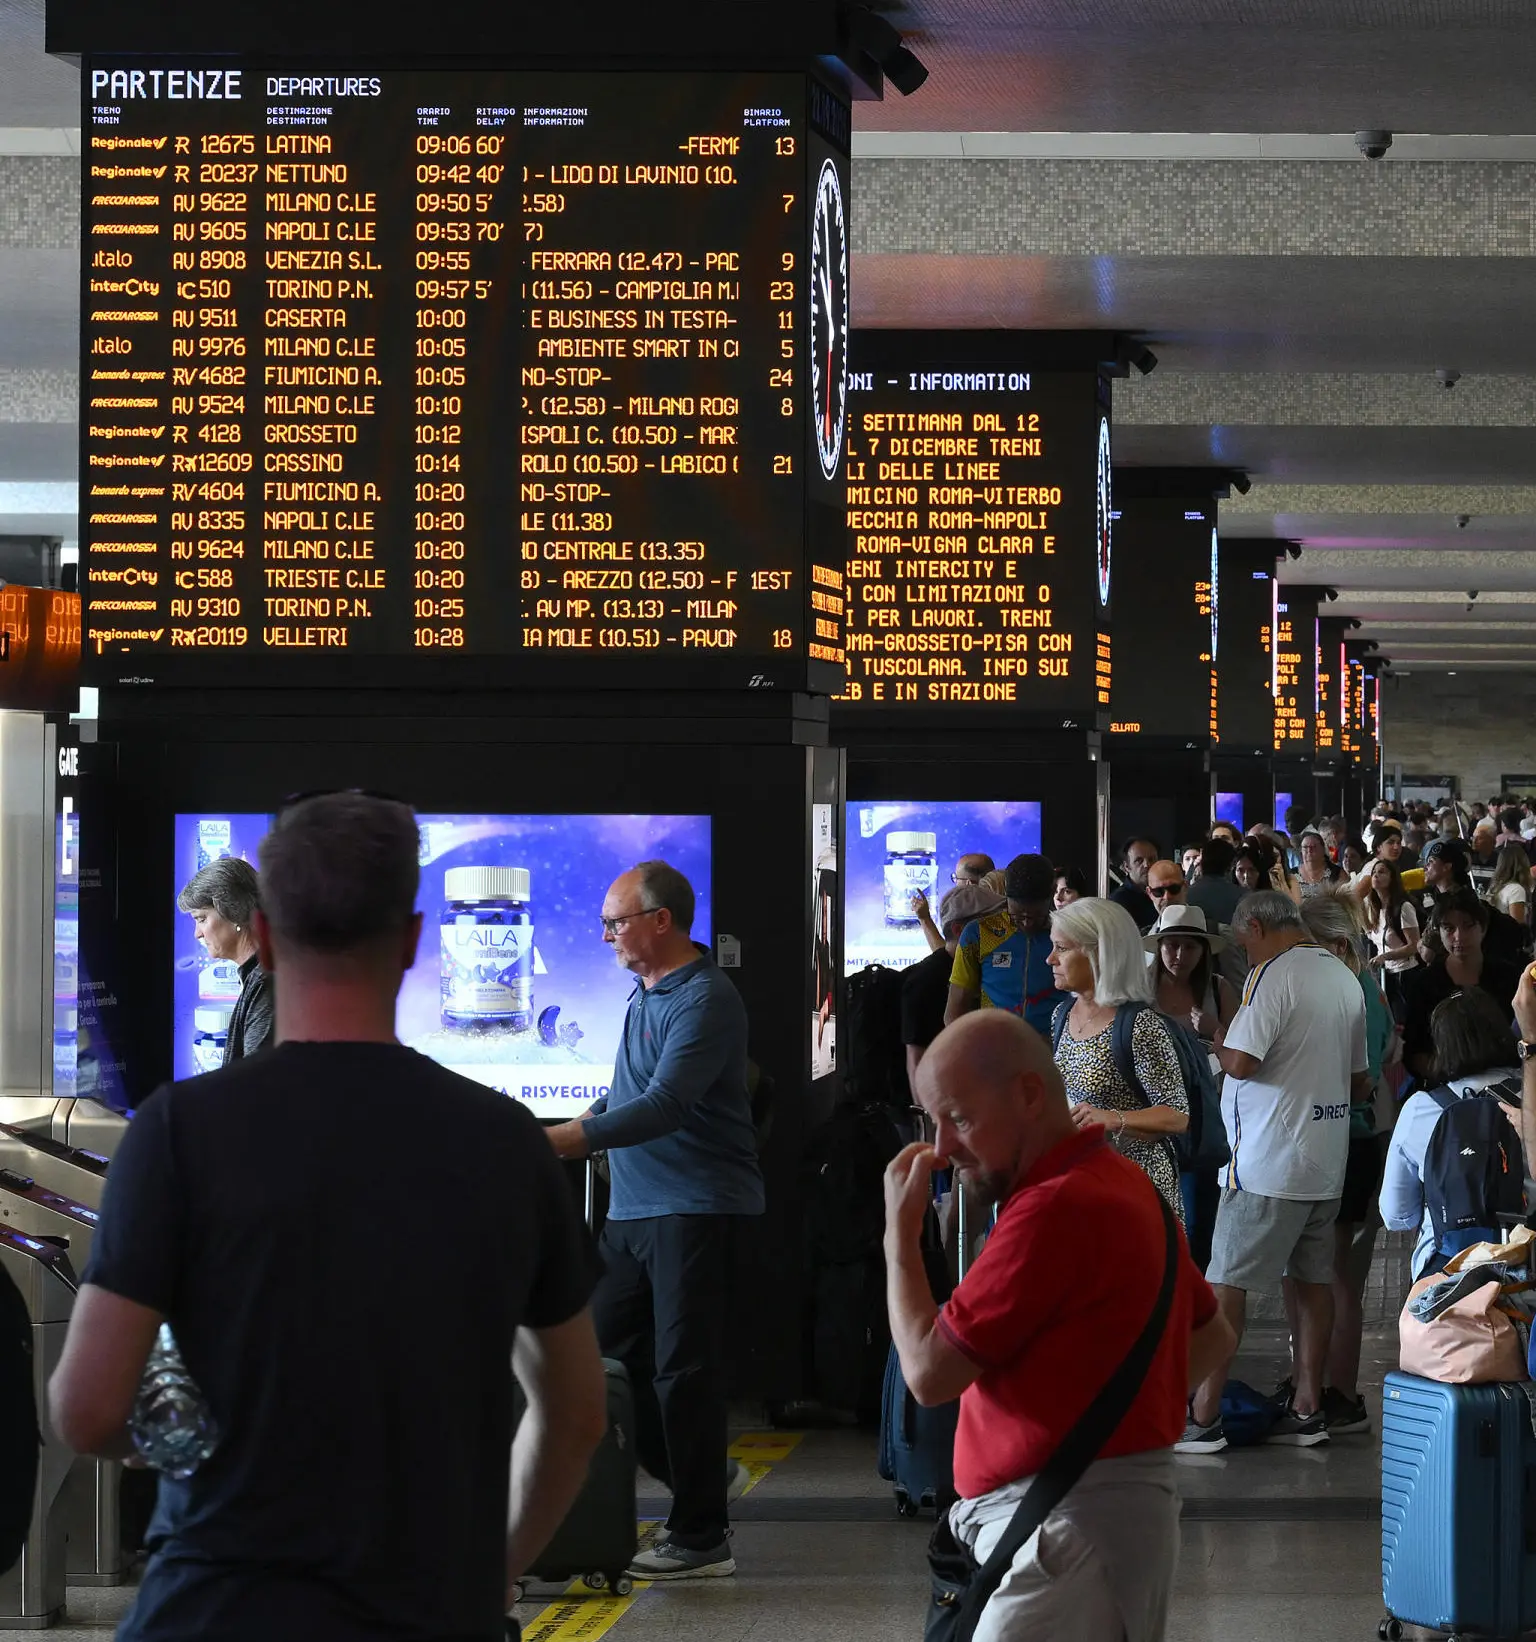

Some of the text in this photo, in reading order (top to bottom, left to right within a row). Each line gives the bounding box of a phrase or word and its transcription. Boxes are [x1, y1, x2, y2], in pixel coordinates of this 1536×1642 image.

[92, 71, 381, 99] PARTENZE DEPARTURES
[524, 118, 584, 126] INFORMATION
[201, 135, 254, 153] 12675
[267, 135, 331, 153] LATINA
[417, 136, 470, 154] 09:06
[776, 137, 794, 155] 13
[201, 164, 698, 184] 20237 NETTUNO 09:42 LIDO DI LAVINIO
[200, 193, 246, 211] 9622
[267, 193, 330, 211] MILANO
[337, 194, 376, 211] C.LE
[417, 194, 470, 212] 09:50
[783, 195, 793, 212] 7
[200, 251, 246, 269] 8908
[266, 251, 342, 269] VENEZIA
[349, 252, 381, 269] S.L.
[416, 252, 470, 269] 09:55
[532, 252, 611, 270] FERRARA
[619, 253, 682, 270] (12.47)
[782, 253, 793, 270] 9
[200, 280, 230, 298] 510
[266, 280, 332, 298] TORINO
[338, 280, 373, 298] P.N.
[416, 281, 469, 298] 09:57
[616, 281, 711, 299] CAMPIGLIA
[771, 282, 793, 300] 23
[200, 309, 793, 328] 9511 CASERTA 10:00 BUSINESS 11
[199, 367, 245, 385] 4682
[265, 367, 358, 385] FIUMICINO
[365, 367, 381, 385] A.
[416, 367, 465, 385] 10:05
[770, 369, 793, 386] 24
[910, 373, 1030, 391] INFORMATION
[864, 414, 1039, 431] SETTIMANA DAL 12
[199, 424, 460, 443] 4128 GROSSETO 10:12
[891, 438, 1041, 455] DICEMBRE TRENI
[198, 453, 792, 473] 12609 CASSINO 10:14 LABICO 21
[880, 463, 1000, 480] DELLE LINEE
[929, 487, 1061, 504] ROMA-VITERBO
[929, 512, 1046, 529] ROMA-NAPOLI
[857, 536, 1032, 553] ROMA-VIGNA CLARA
[896, 560, 993, 578] INTERCITY
[198, 569, 232, 587] 588
[264, 569, 340, 587] TRIESTE
[347, 570, 385, 588] C.LE
[415, 570, 464, 588] 10:20
[751, 572, 792, 589] 1EST
[863, 585, 1024, 602] CON LIMITAZIONI
[868, 609, 1051, 627] PER LAVORI. TRENI
[197, 627, 791, 647] 20119 VELLETRI 10:28 18
[1039, 634, 1071, 651] CON
[863, 658, 1068, 676] TUSCOLANA. INFO SUI
[896, 683, 1016, 700] IN STAZIONE
[59, 747, 78, 776] GATE
[62, 797, 73, 875] E
[455, 929, 518, 946] LAILA
[521, 1085, 610, 1099] RISVEGLIO
